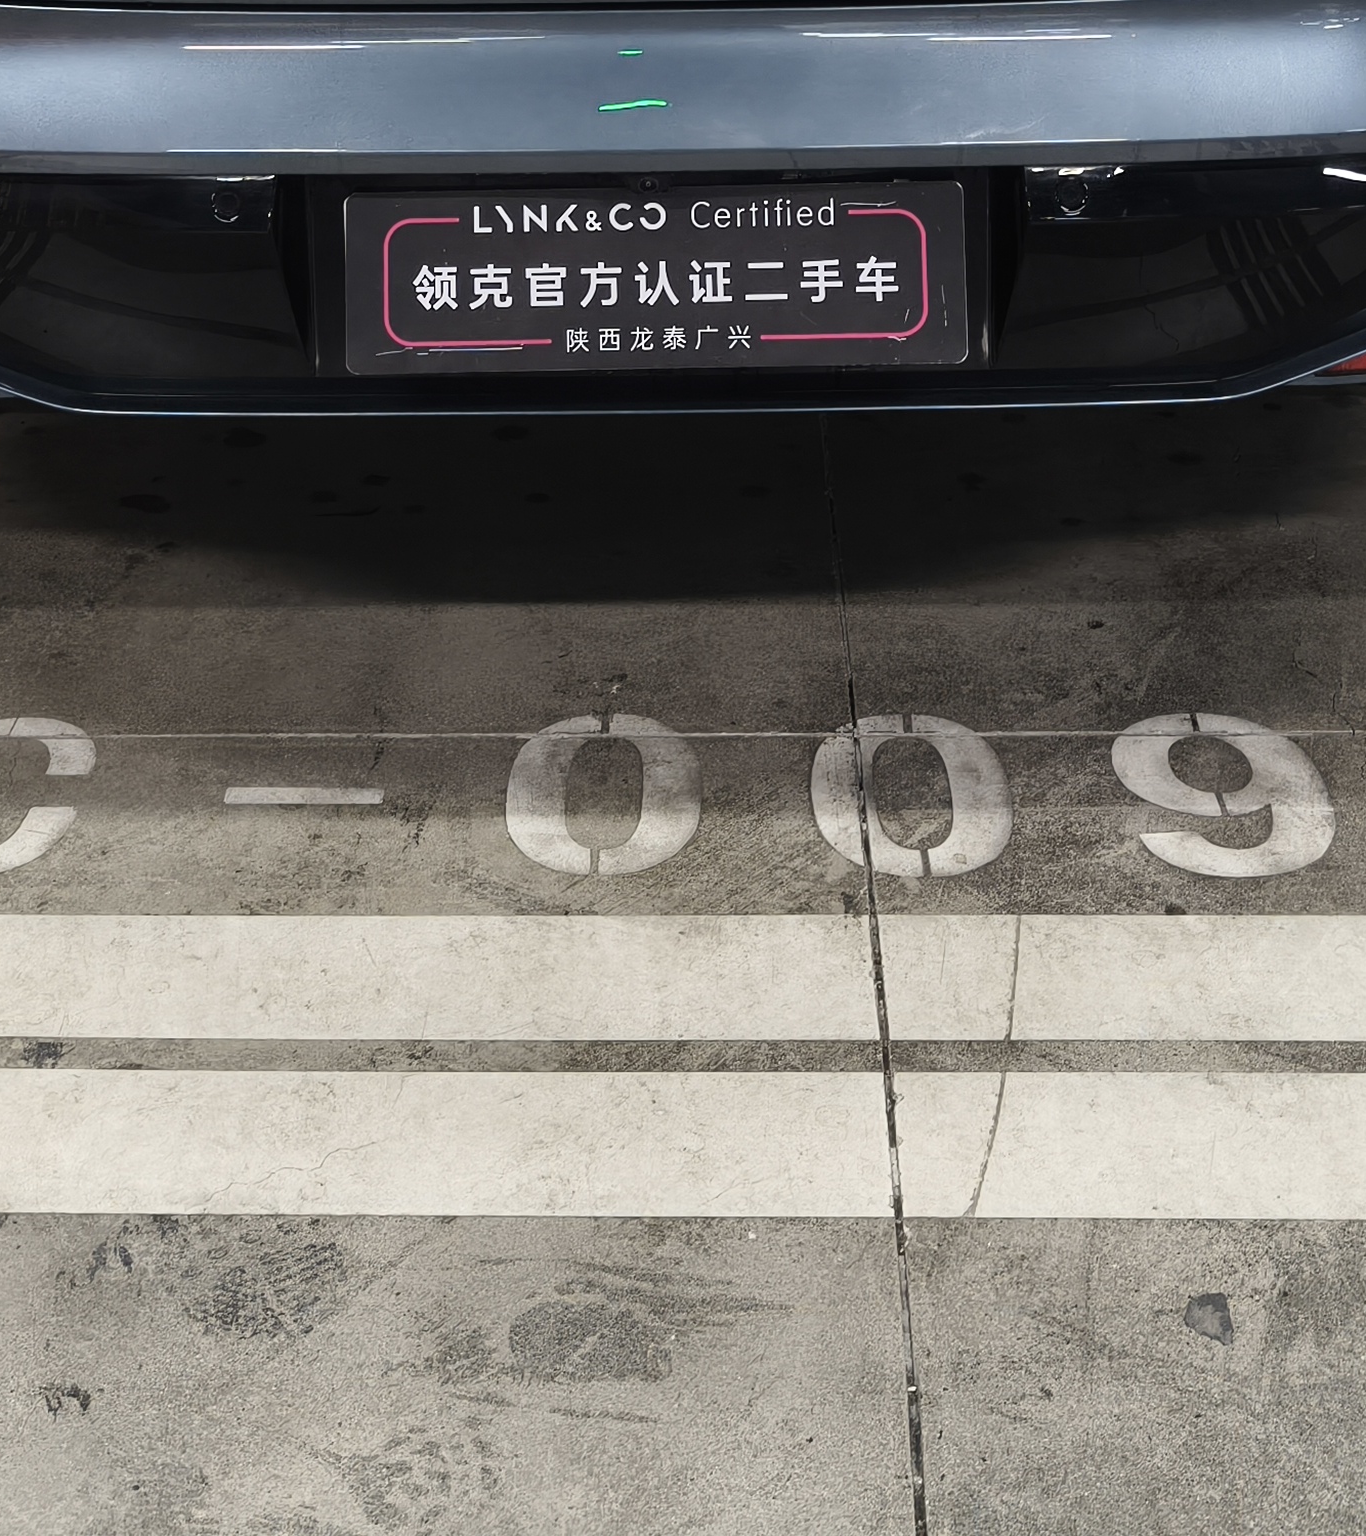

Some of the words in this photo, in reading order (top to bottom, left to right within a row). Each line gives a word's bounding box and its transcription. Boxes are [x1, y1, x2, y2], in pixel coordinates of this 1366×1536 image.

[473, 202, 667, 234] LYNK&CO
[689, 198, 836, 228] Certified
[412, 255, 901, 310] 领克官方认证二手车
[565, 325, 752, 354] 陕西龙泰广兴
